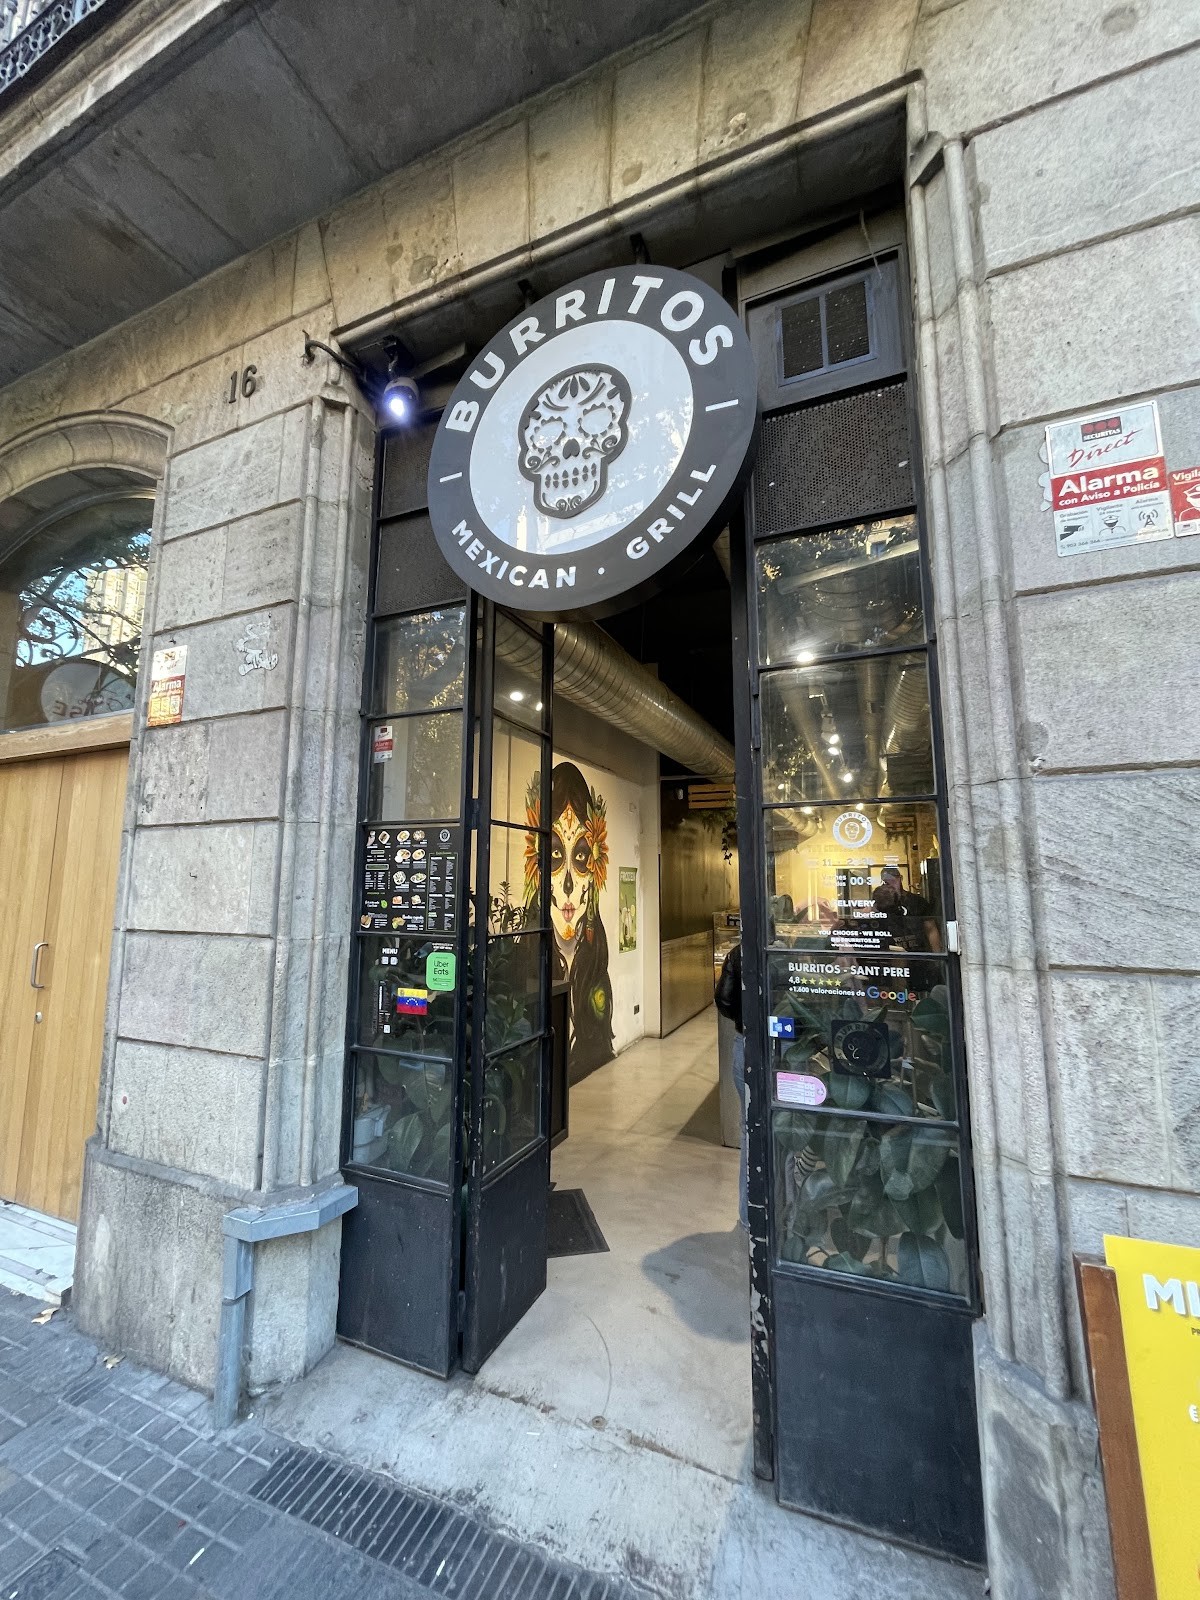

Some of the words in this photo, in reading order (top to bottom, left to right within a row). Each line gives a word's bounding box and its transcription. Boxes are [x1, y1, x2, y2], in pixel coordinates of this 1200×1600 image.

[445, 275, 734, 433] BURRITOS
[228, 364, 258, 404] 16
[1067, 428, 1144, 468] Direct
[1083, 428, 1121, 441] SECURITAS
[1058, 466, 1160, 497] Alarma
[1058, 497, 1078, 507] con
[1081, 490, 1110, 503] Aviso
[1123, 480, 1160, 494] Policía
[626, 464, 717, 560] GRILL
[451, 519, 577, 589] MEXICAN
[152, 679, 182, 693] Alarma
[434, 960, 449, 968] Uber
[788, 962, 841, 974] BURRITOS
[850, 965, 880, 977] SANT
[883, 967, 910, 978] PERE
[788, 976, 800, 984] 4,8
[810, 987, 855, 997] valoraciones
[866, 986, 917, 1004] Google
